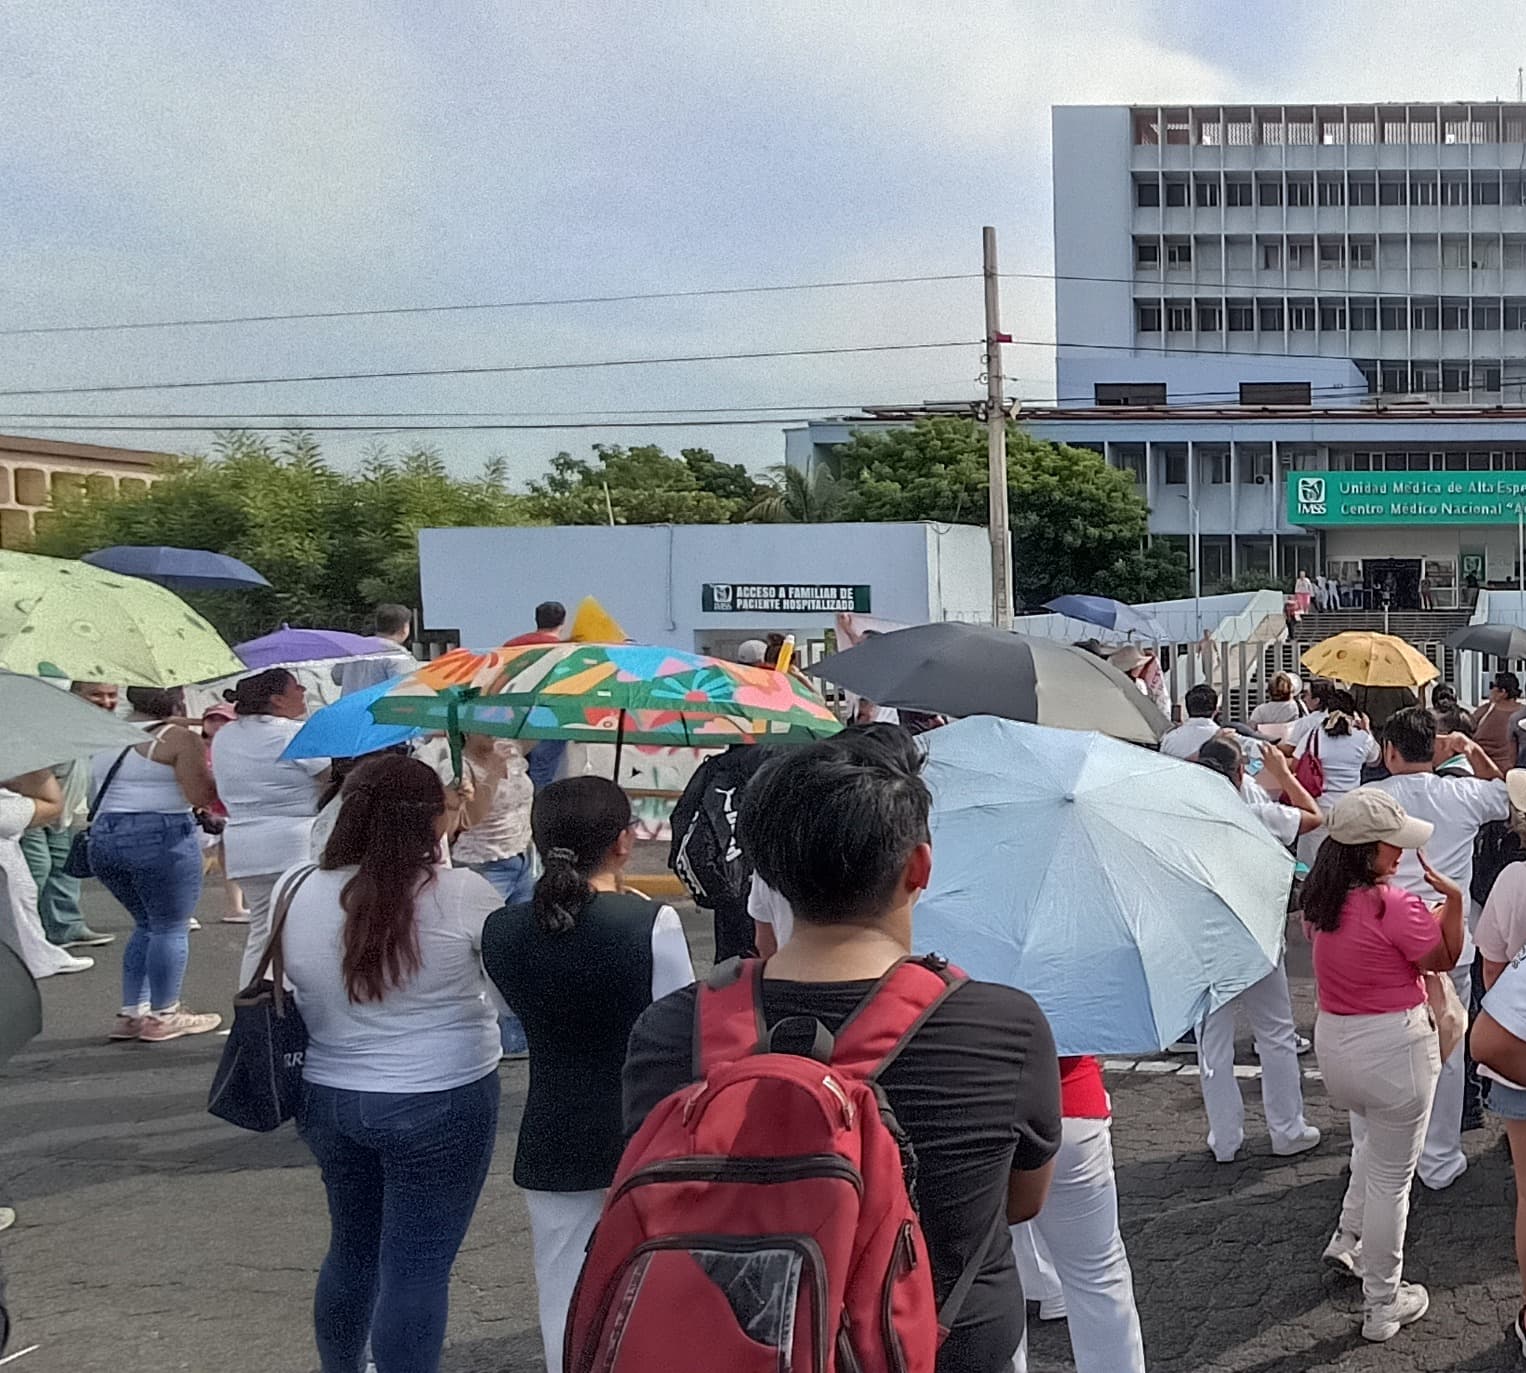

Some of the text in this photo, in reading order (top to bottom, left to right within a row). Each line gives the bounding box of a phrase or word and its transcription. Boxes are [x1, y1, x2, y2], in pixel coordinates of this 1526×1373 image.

[1340, 481, 1387, 494] Unidad
[1393, 481, 1441, 494] Médica
[1447, 482, 1463, 493] de
[1468, 481, 1494, 493] Alta
[1298, 503, 1327, 514] IMSS
[1341, 502, 1384, 515] Centro
[1391, 502, 1437, 515] Médico
[1441, 502, 1501, 515] Nacional
[736, 586, 854, 600] ACCESO A FAMILIAR DE
[736, 598, 855, 611] PACIENTE HOSPITALIZADO
